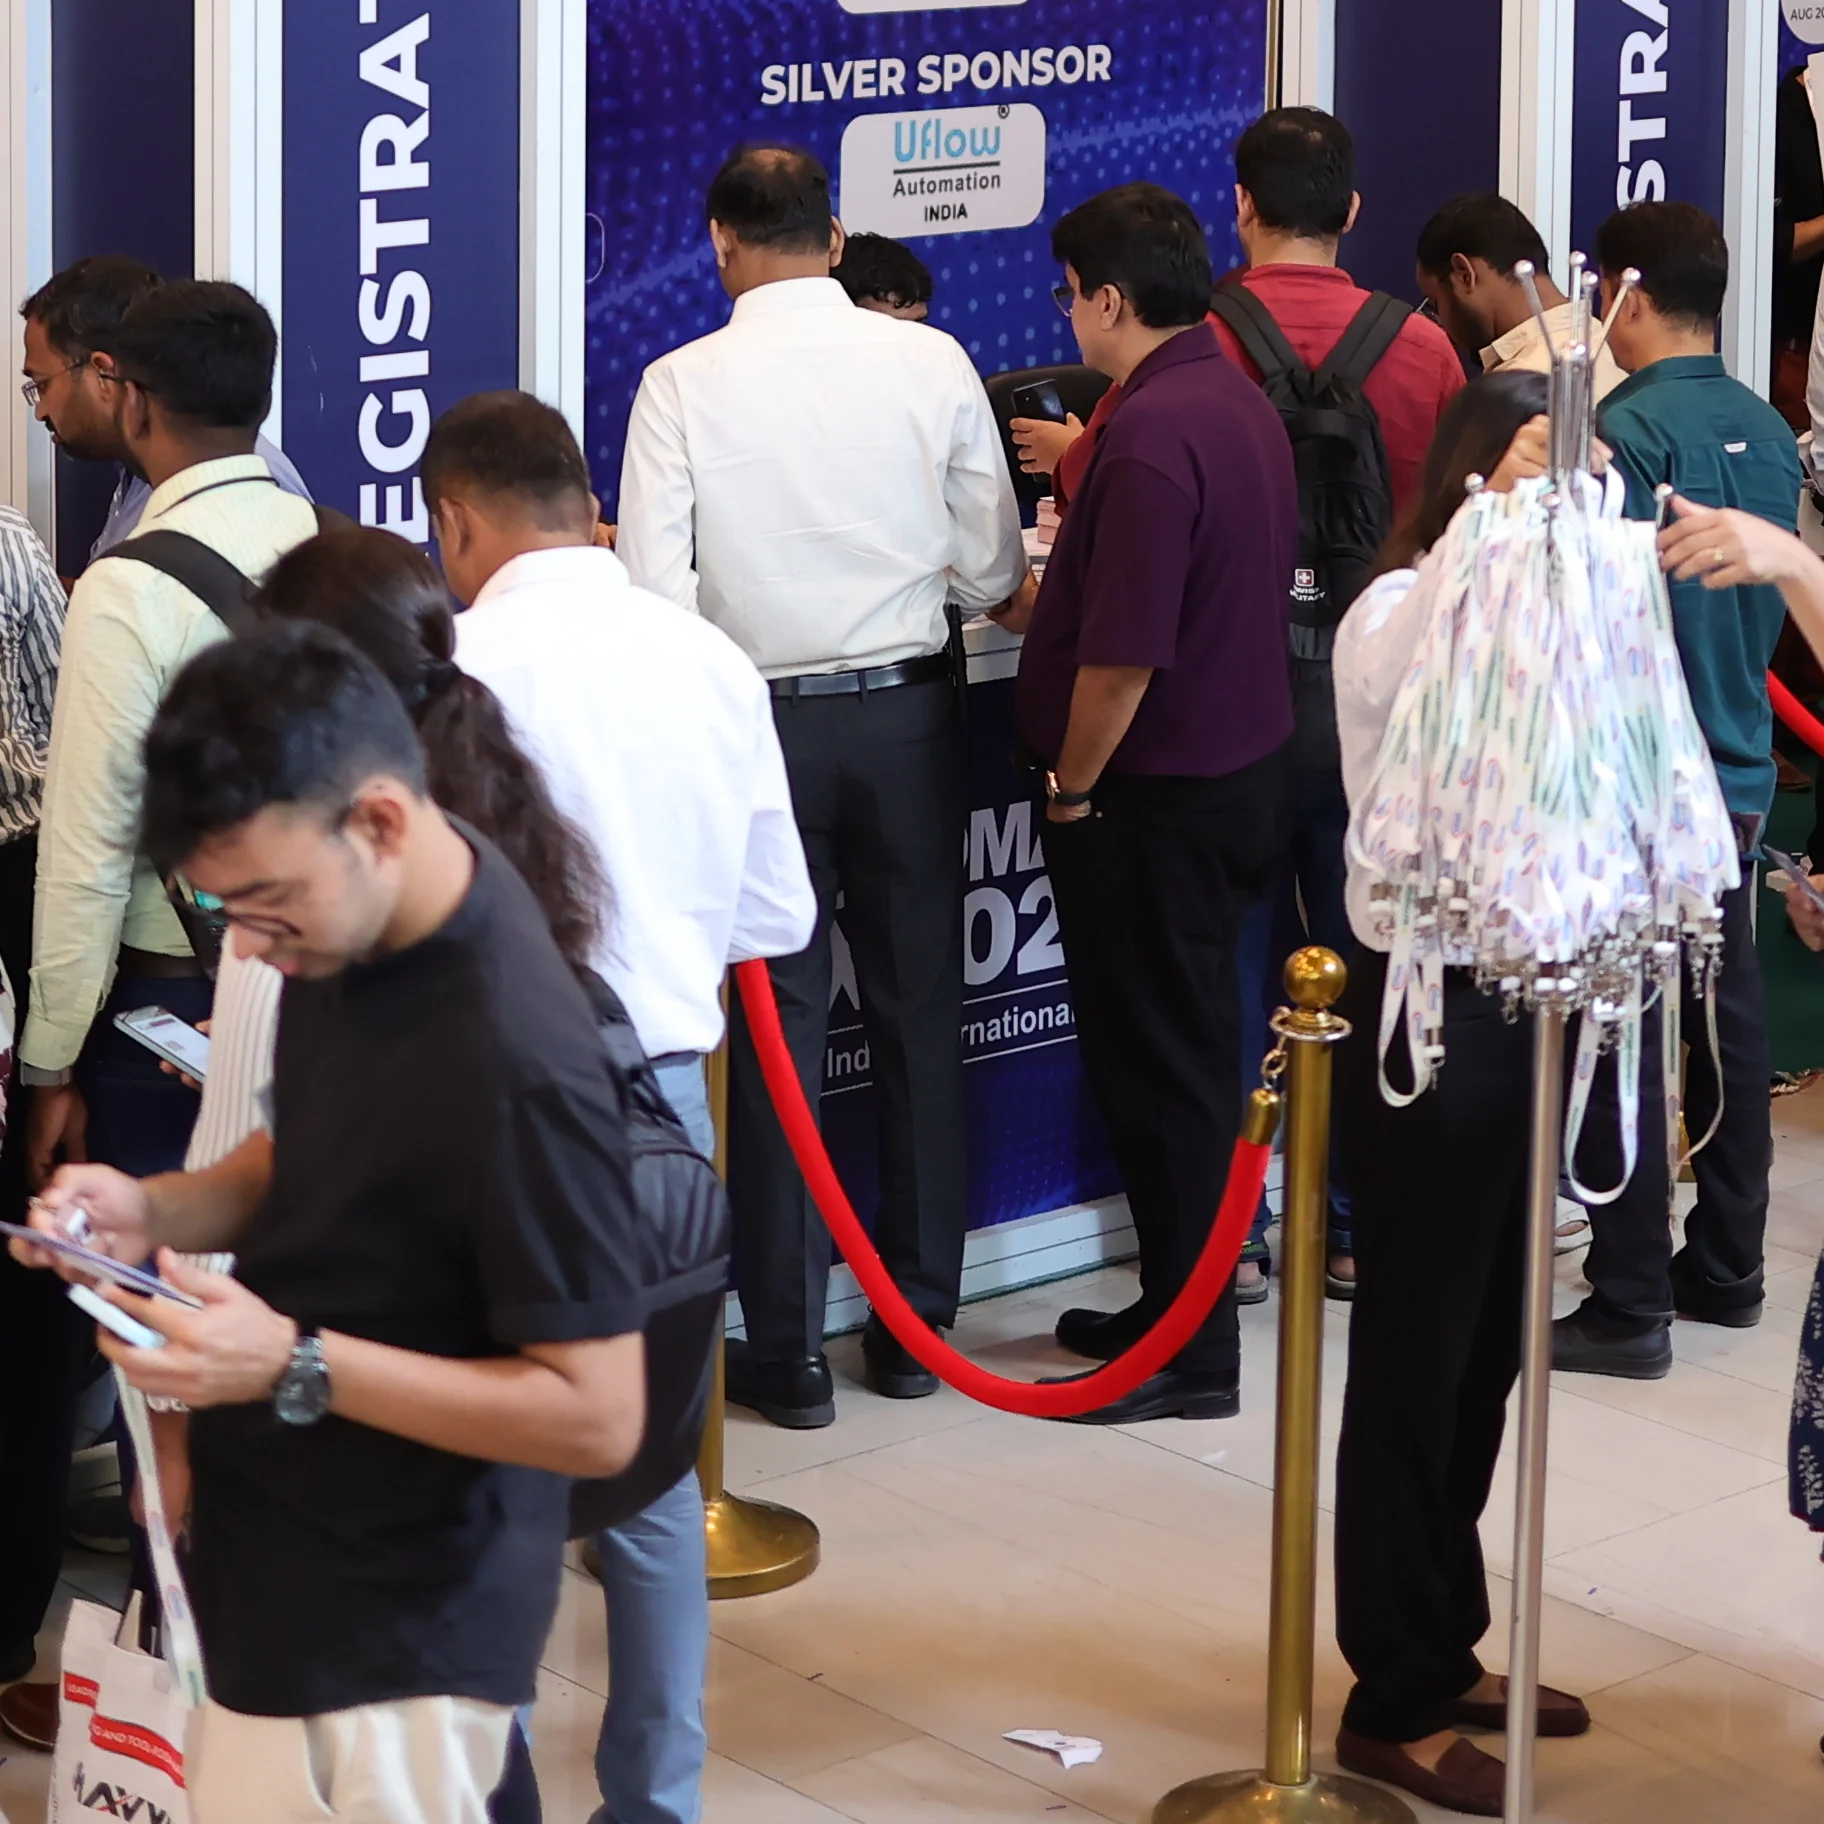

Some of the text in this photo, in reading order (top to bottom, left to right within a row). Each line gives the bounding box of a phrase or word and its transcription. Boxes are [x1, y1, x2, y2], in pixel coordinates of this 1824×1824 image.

[1790, 6, 1814, 21] AUG
[760, 43, 1113, 106] SILVER SPONSOR
[892, 170, 1002, 198] Automation
[923, 203, 969, 223] INDIA
